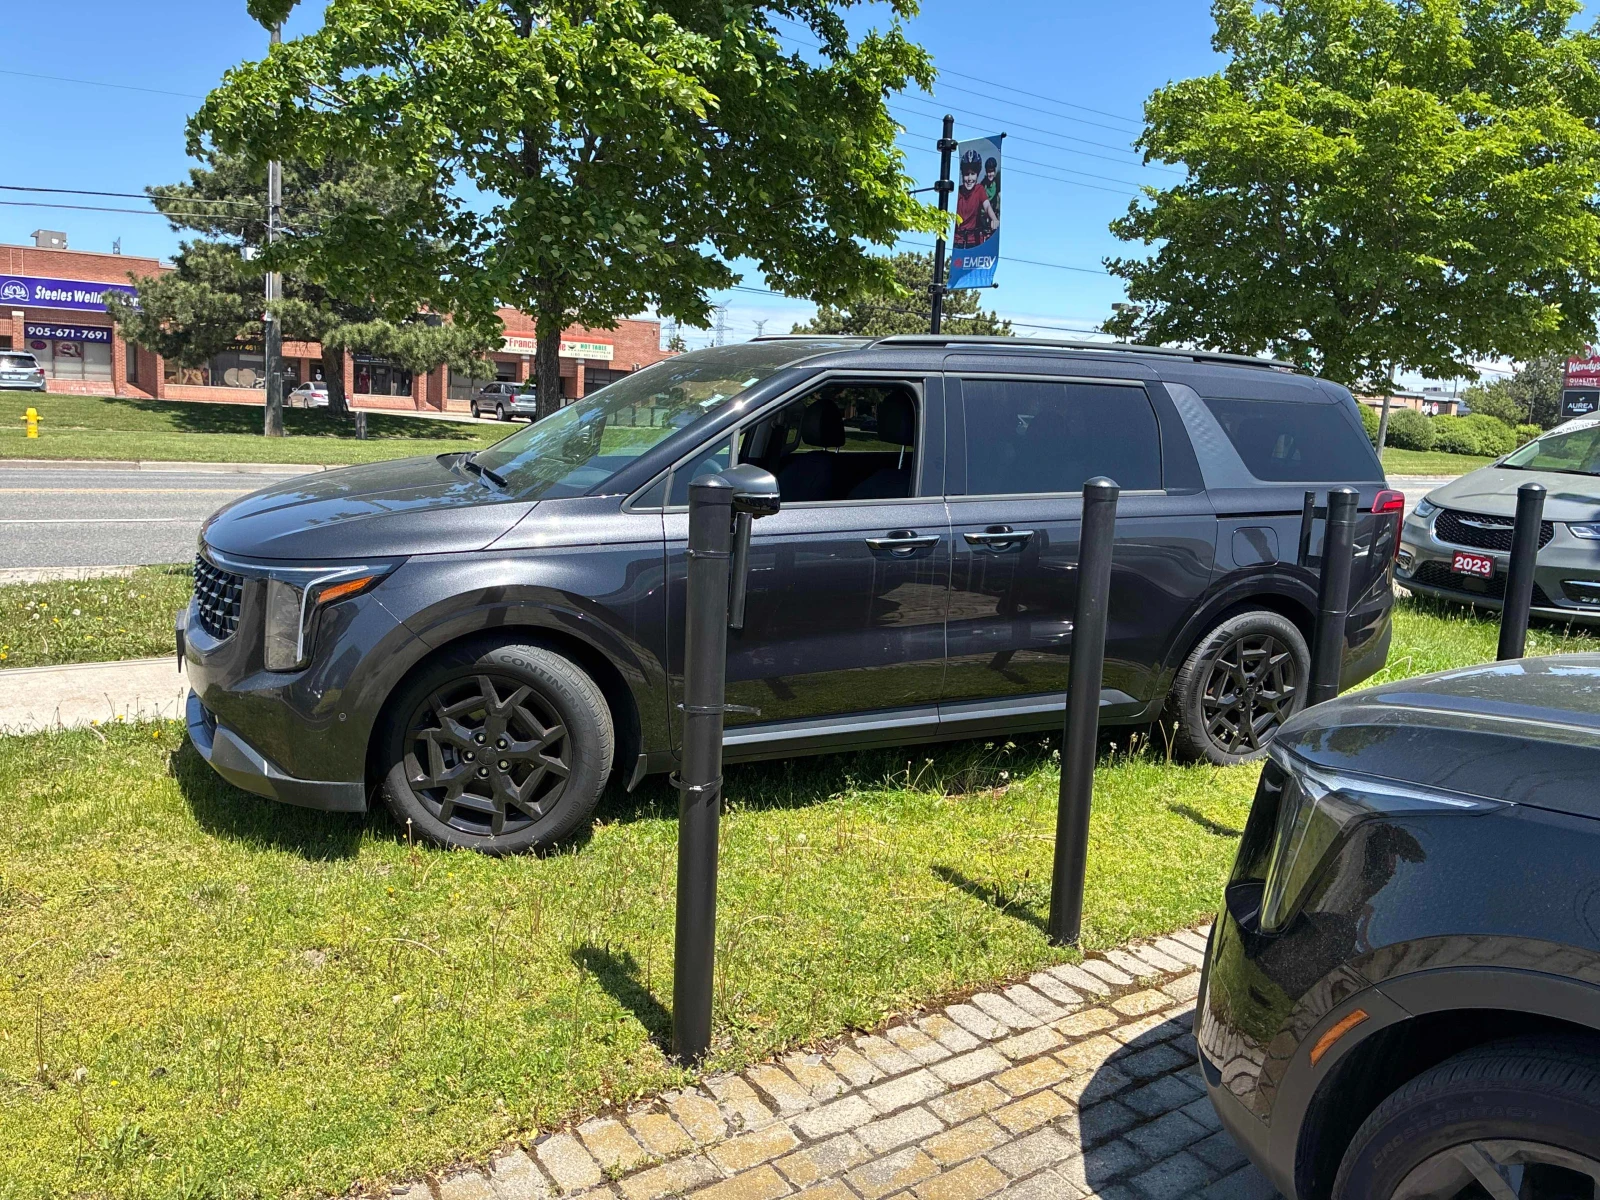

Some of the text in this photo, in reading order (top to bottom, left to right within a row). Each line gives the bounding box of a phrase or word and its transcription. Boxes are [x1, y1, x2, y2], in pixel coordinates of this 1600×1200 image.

[963, 255, 996, 268] EMERY
[35, 286, 72, 301] Steeles
[74, 290, 103, 304] Welln
[28, 326, 108, 339] 905-671-7691
[1454, 556, 1491, 573] 2023
